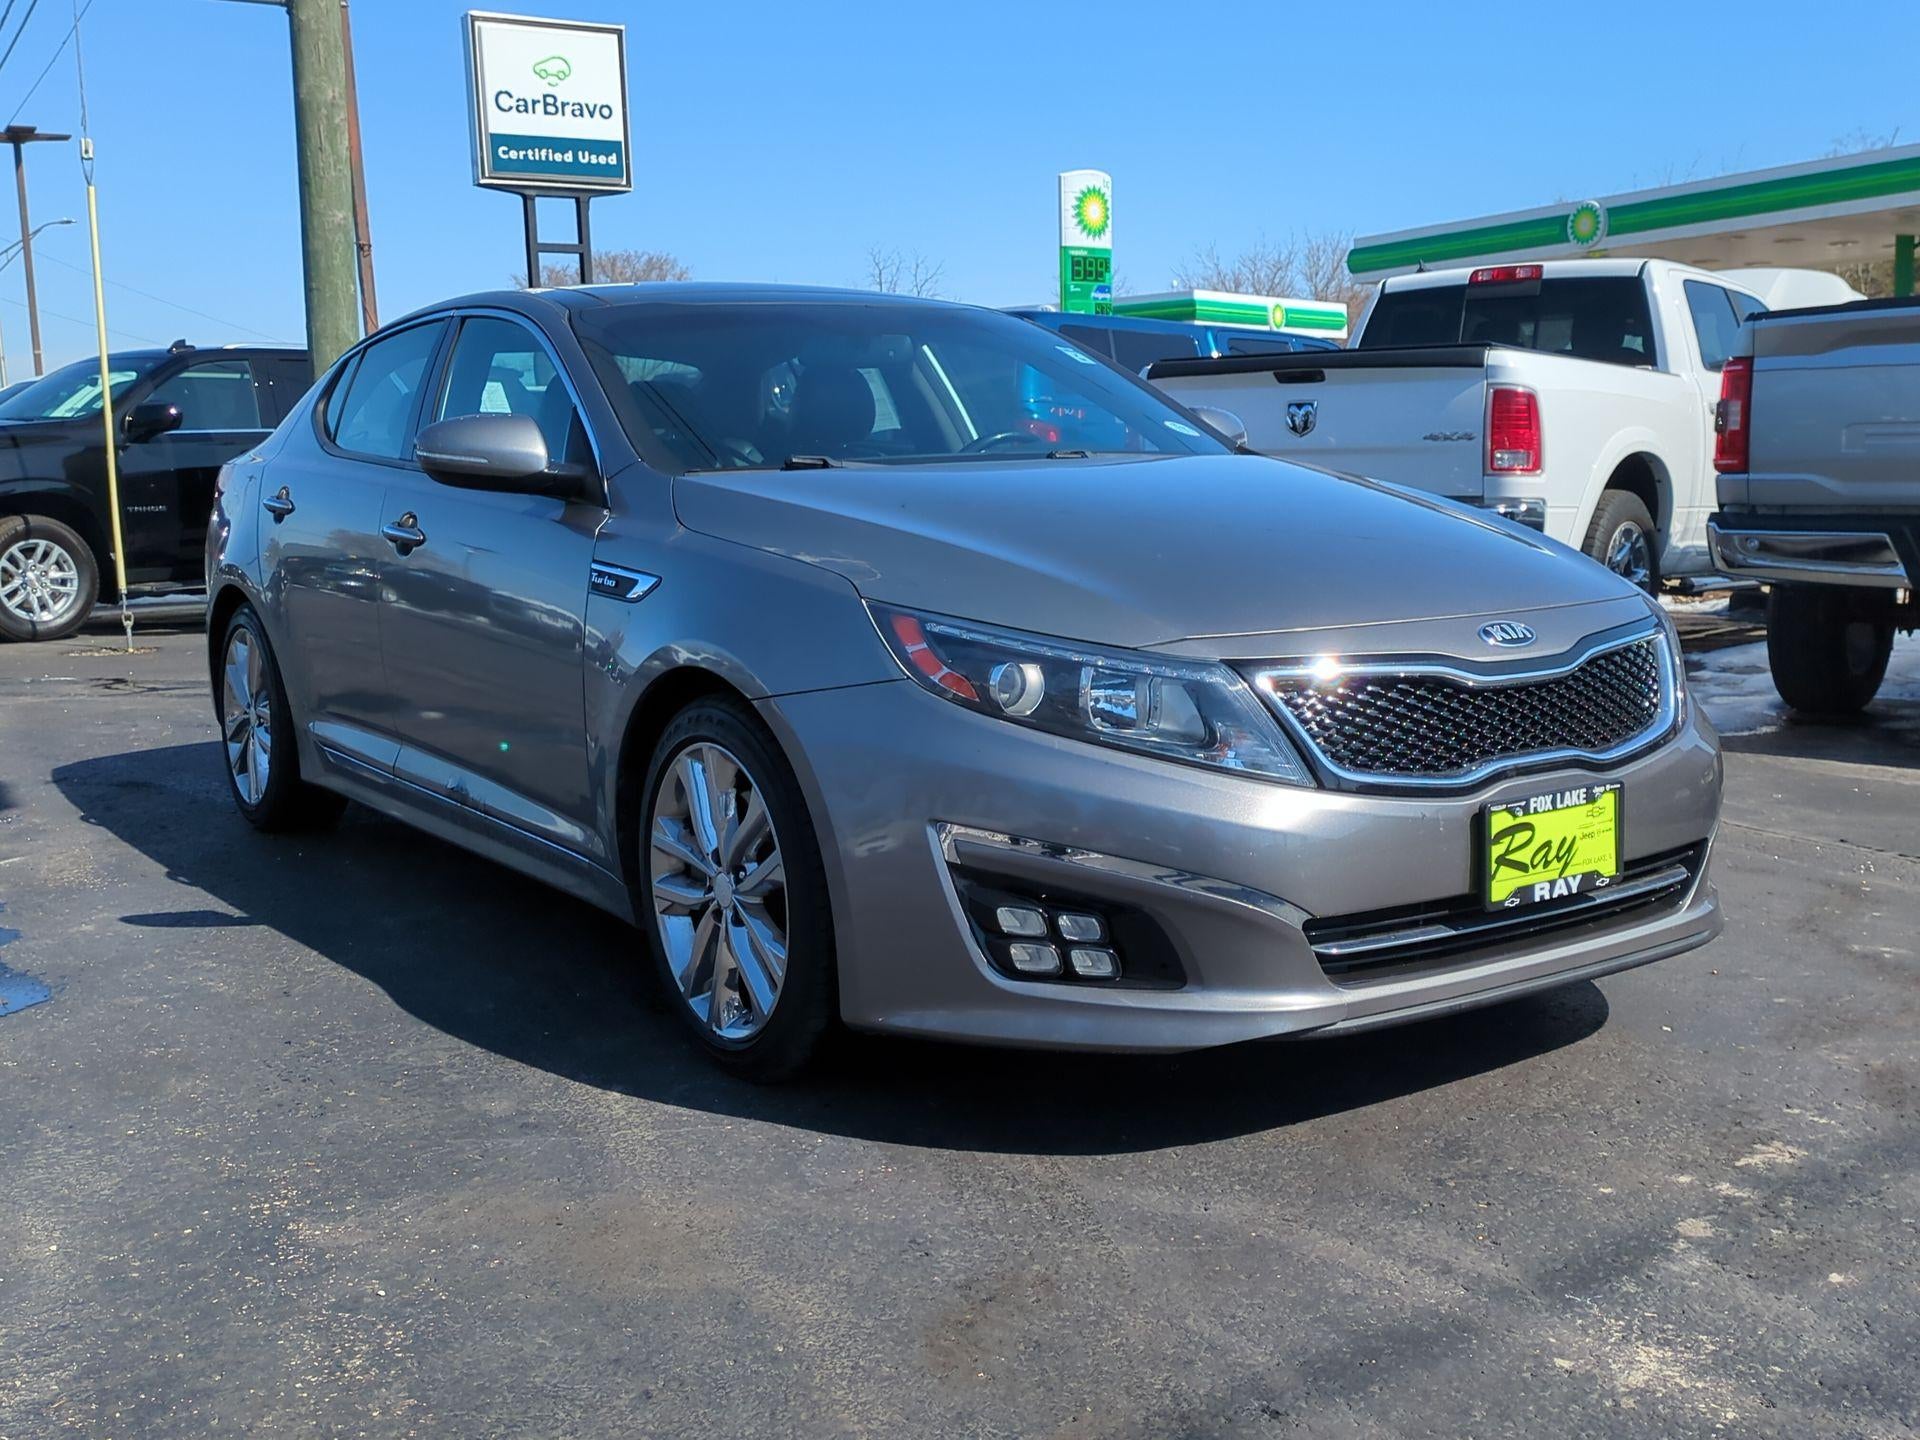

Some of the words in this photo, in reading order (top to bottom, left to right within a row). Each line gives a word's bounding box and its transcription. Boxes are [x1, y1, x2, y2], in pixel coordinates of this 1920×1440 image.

[494, 90, 613, 119] CarBravo
[497, 146, 573, 163] Certified
[578, 150, 617, 165] Used
[591, 572, 617, 587] Turbo
[1485, 623, 1533, 641] KIA
[1529, 794, 1554, 814] FOX
[1556, 788, 1587, 809] LAKE
[1491, 821, 1577, 882] Ray
[1534, 874, 1582, 902] RAY
